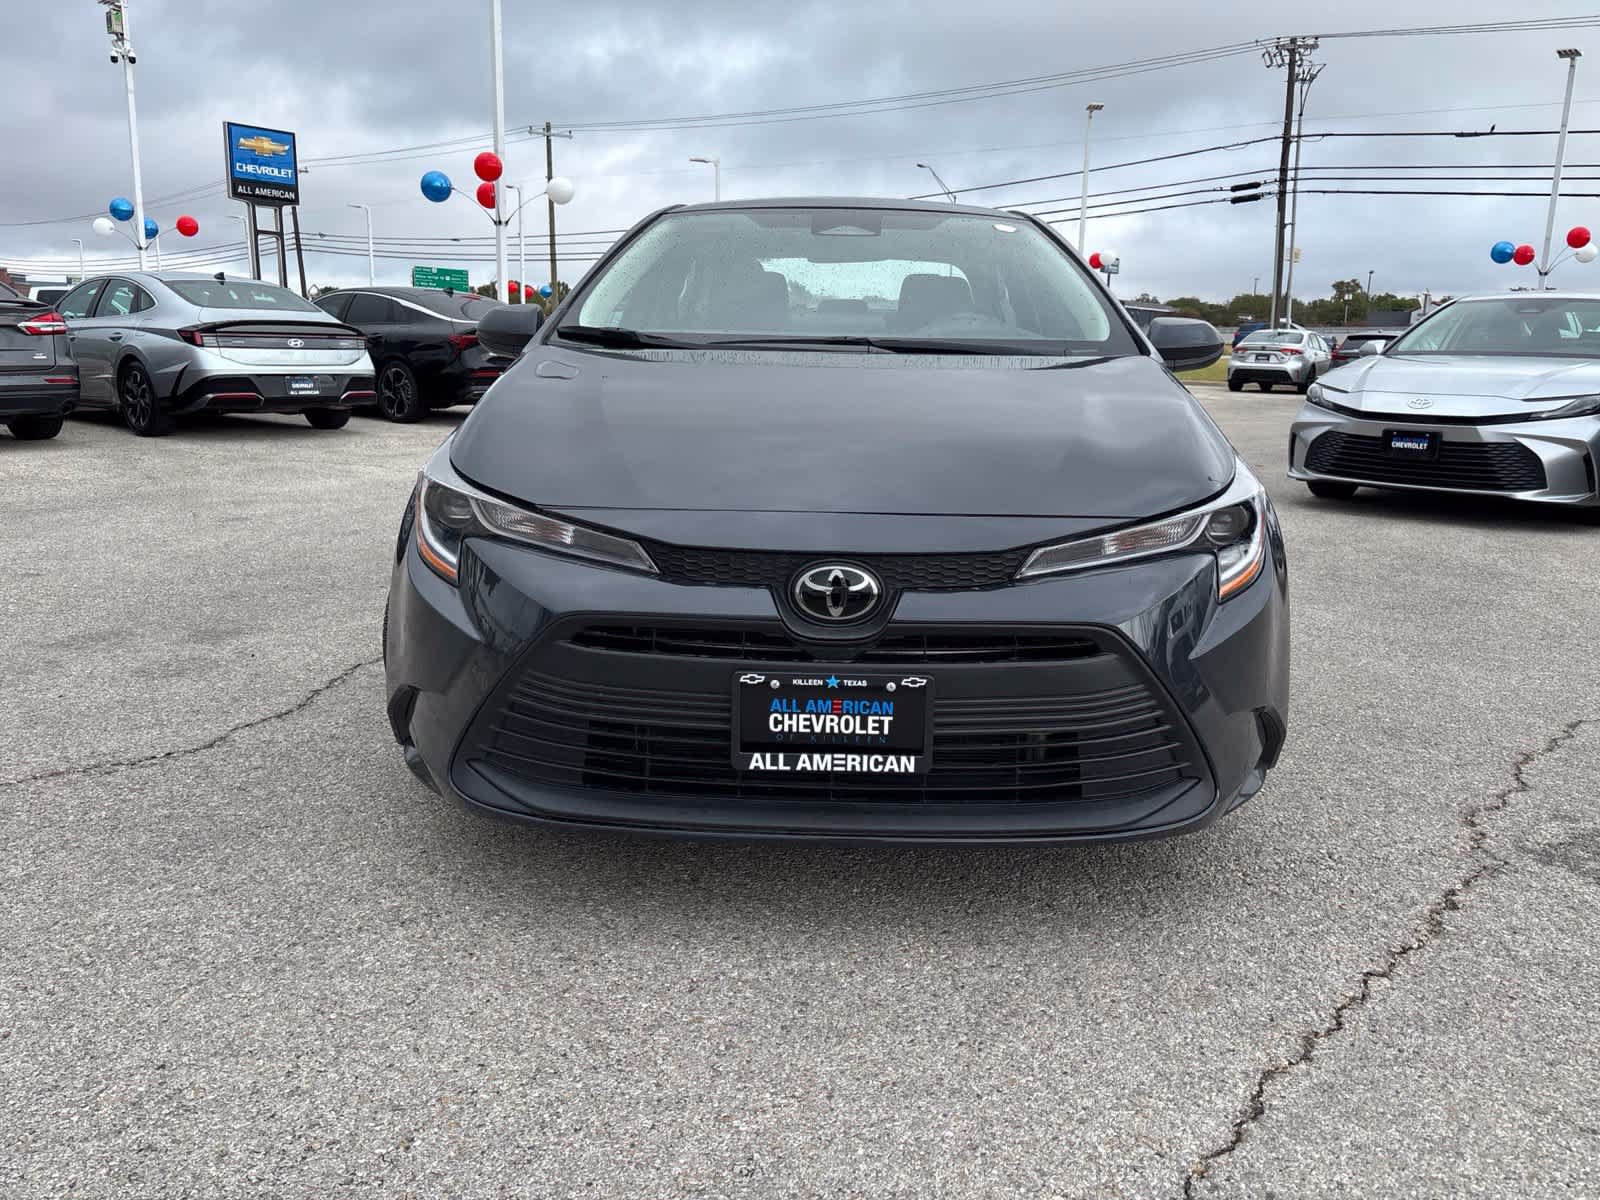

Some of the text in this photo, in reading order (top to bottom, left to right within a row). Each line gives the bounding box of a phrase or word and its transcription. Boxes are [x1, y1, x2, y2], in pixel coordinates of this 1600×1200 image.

[236, 163, 293, 178] CHEVROLET
[237, 185, 295, 200] ALL AMERICAN
[1391, 441, 1428, 450] CHEVROLET
[770, 698, 894, 715] ALL AMERICAN
[769, 713, 894, 735] CHEVROLET
[749, 753, 916, 773] ALL AMERICAN
